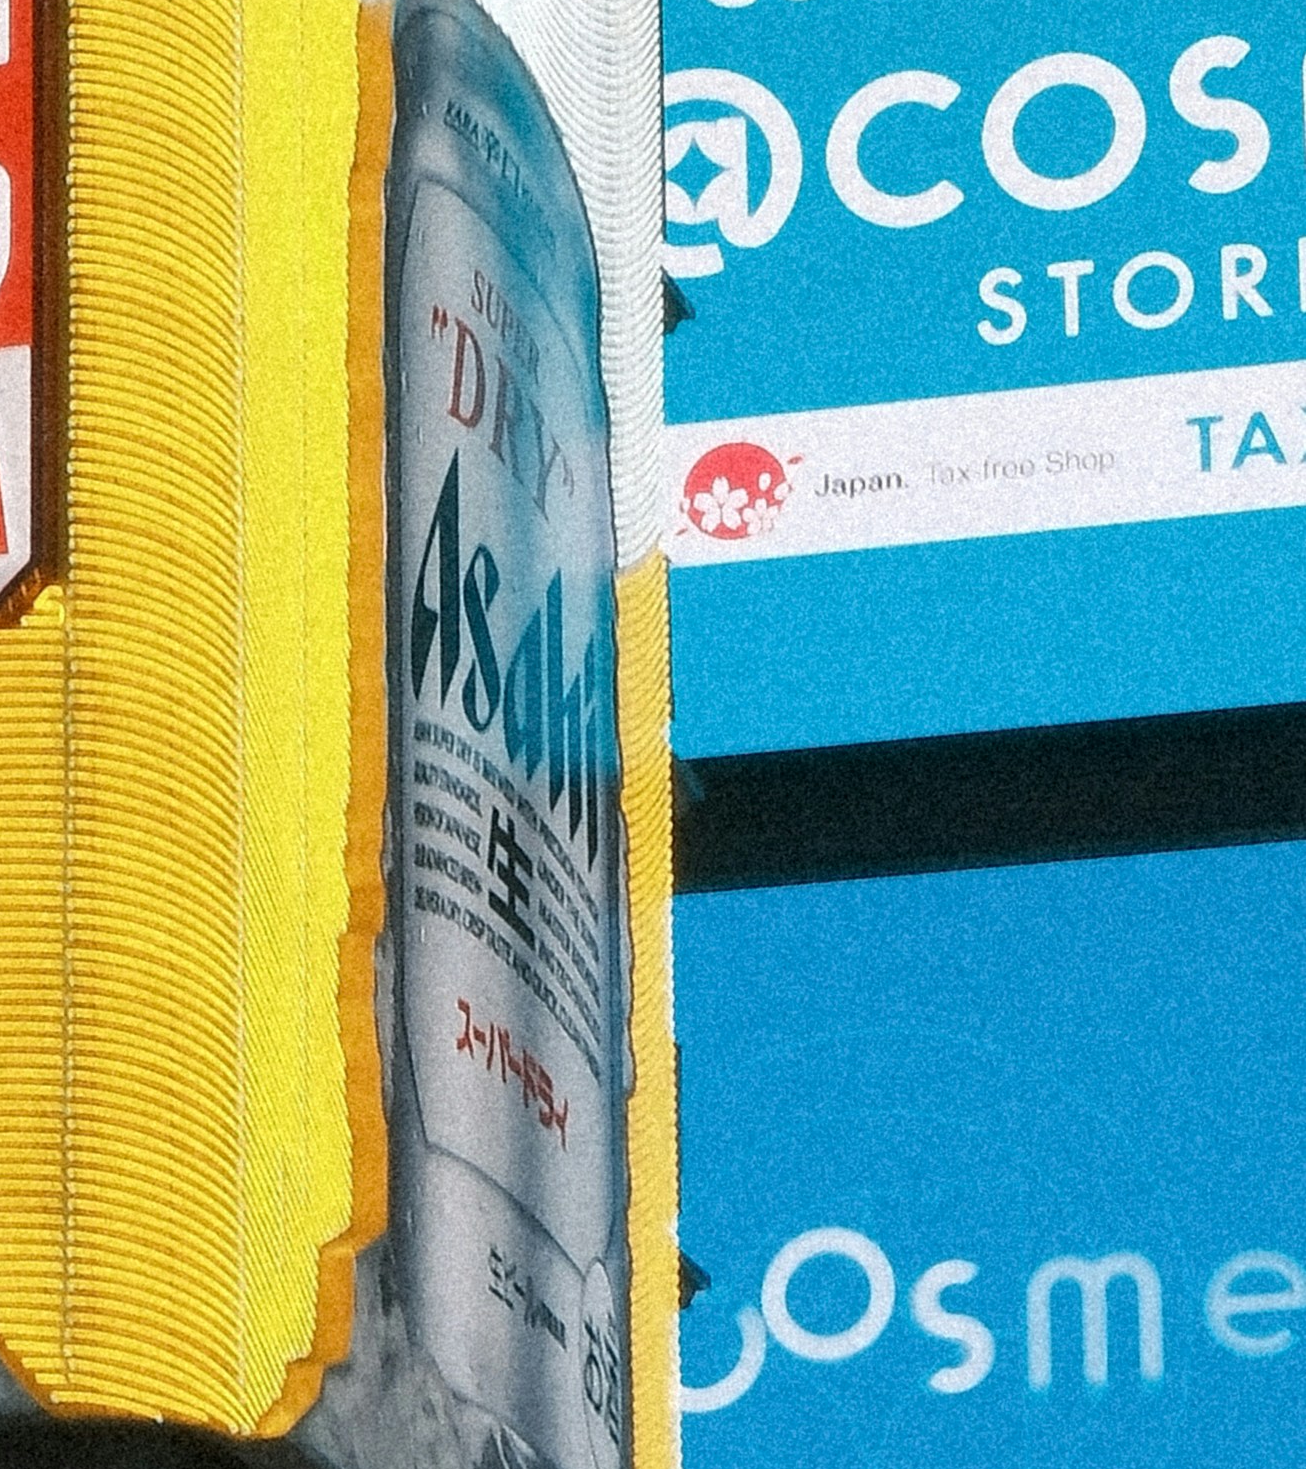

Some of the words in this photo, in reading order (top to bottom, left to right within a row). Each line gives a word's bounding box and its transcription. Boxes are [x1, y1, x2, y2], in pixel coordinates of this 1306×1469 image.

[976, 236, 1306, 346] STOR
[1044, 449, 1116, 476] Shop
[410, 447, 598, 872] Asahi
